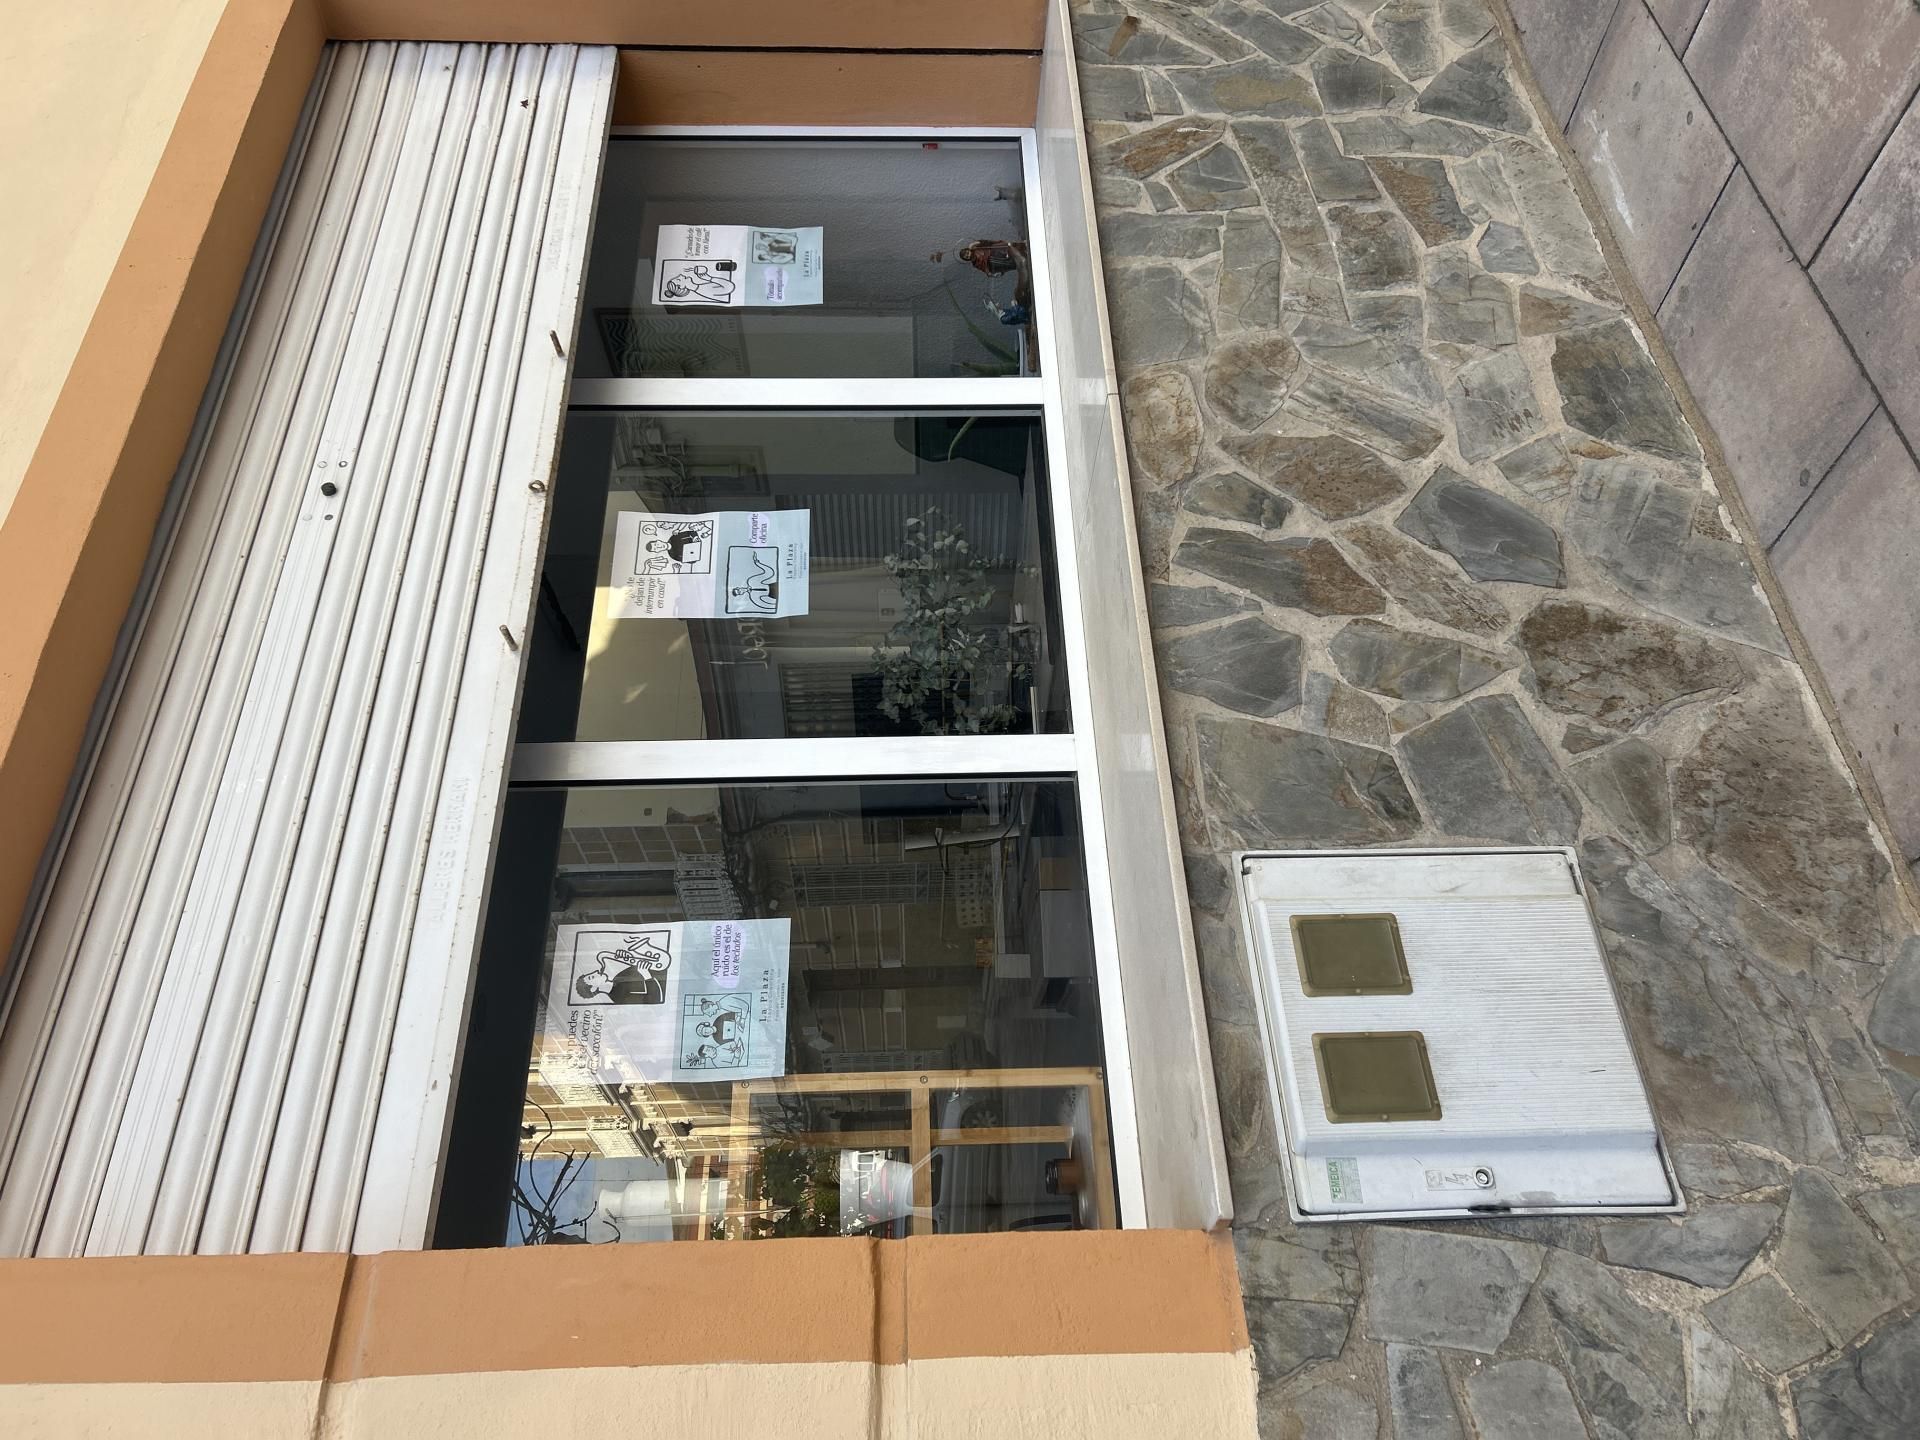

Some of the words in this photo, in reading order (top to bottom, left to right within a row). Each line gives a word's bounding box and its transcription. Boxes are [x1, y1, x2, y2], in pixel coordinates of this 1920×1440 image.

[749, 513, 760, 544] Comparte
[759, 523, 767, 544] oficina
[636, 578, 645, 586] de
[786, 571, 792, 579] La
[635, 587, 645, 606] dejan
[657, 599, 665, 608] en
[712, 925, 722, 948] único
[723, 924, 732, 934] de
[724, 945, 730, 953] es
[732, 932, 741, 963] teclados
[711, 958, 723, 977] Aquí
[722, 955, 730, 977] ruido
[760, 970, 768, 1002] Plaza
[759, 1009, 767, 1022] La
[567, 1010, 578, 1046] puedes
[580, 1010, 591, 1042] vecino
